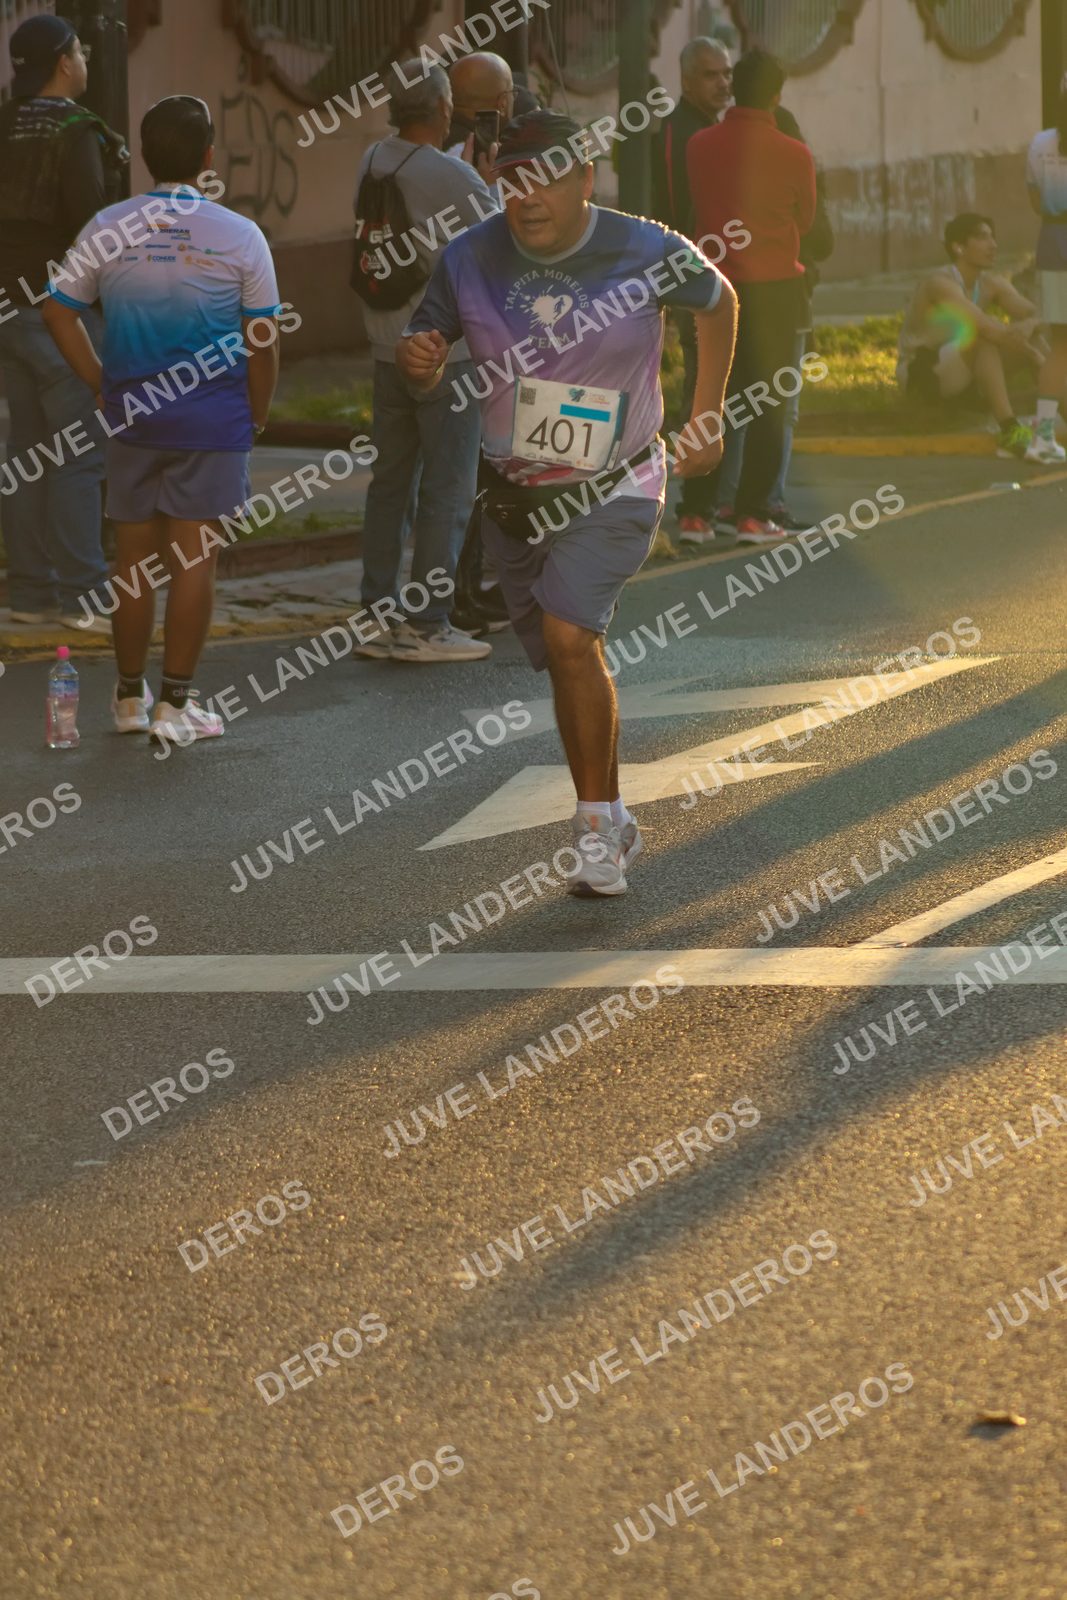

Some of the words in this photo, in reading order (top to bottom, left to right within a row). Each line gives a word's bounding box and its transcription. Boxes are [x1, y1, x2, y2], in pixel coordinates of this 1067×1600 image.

[504, 269, 540, 311] TALPITA
[544, 268, 590, 309] MORELOS
[526, 416, 593, 458] 401
